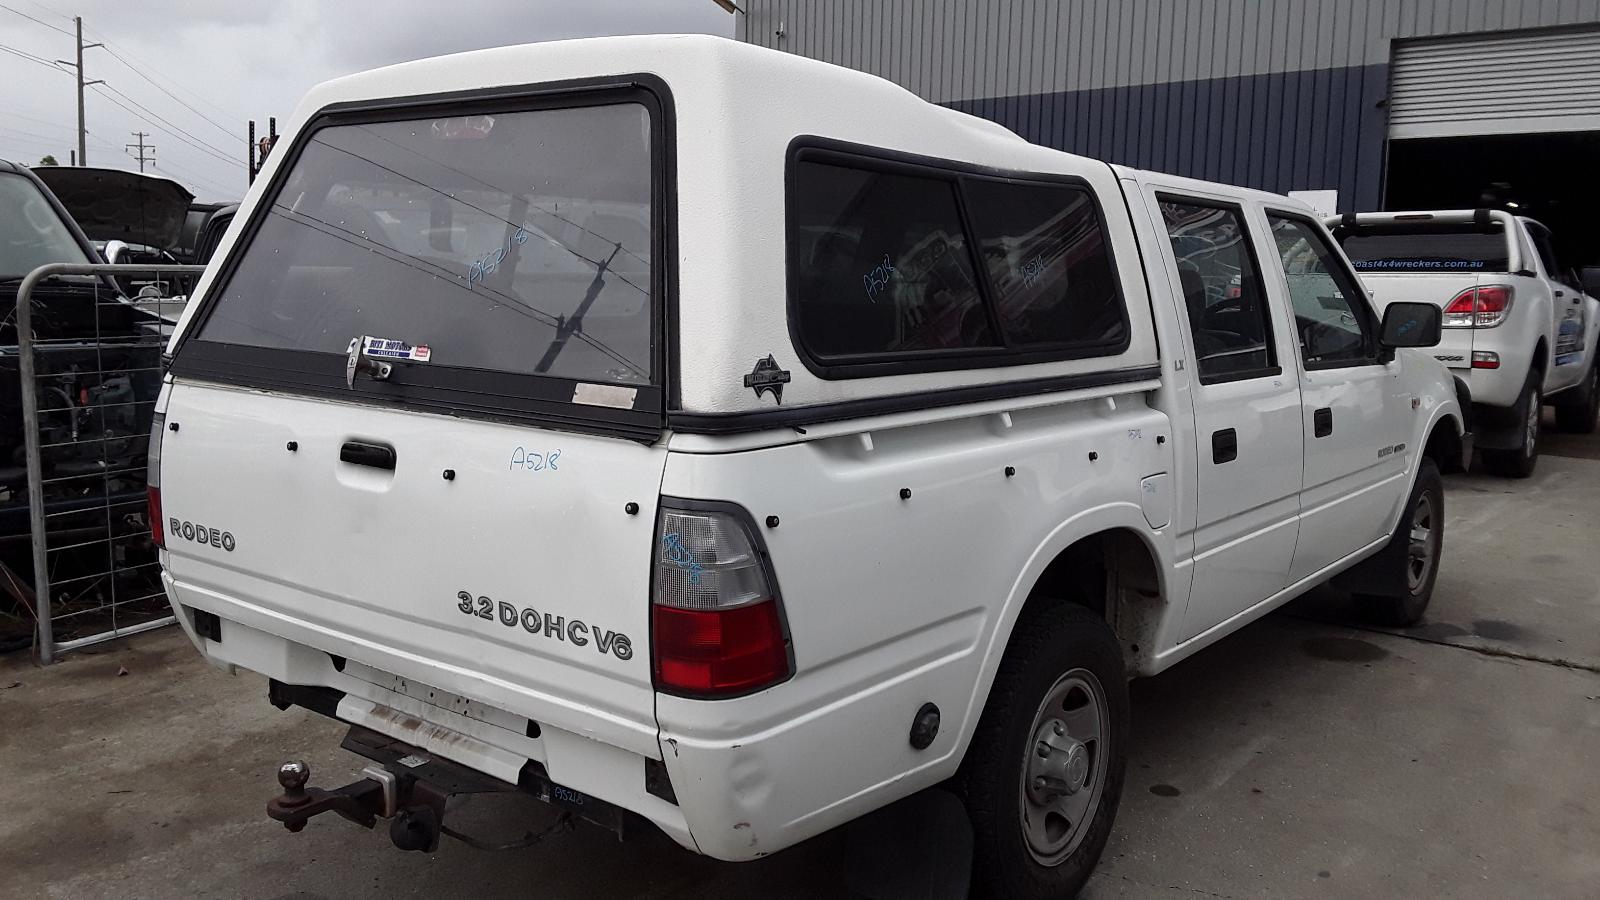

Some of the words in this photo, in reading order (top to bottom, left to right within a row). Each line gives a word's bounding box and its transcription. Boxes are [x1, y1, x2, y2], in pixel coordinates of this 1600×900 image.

[509, 446, 562, 471] A5218
[169, 517, 236, 552] RODEO
[457, 590, 494, 621] 3.2
[499, 600, 589, 647] DOHC
[592, 625, 633, 661] V6
